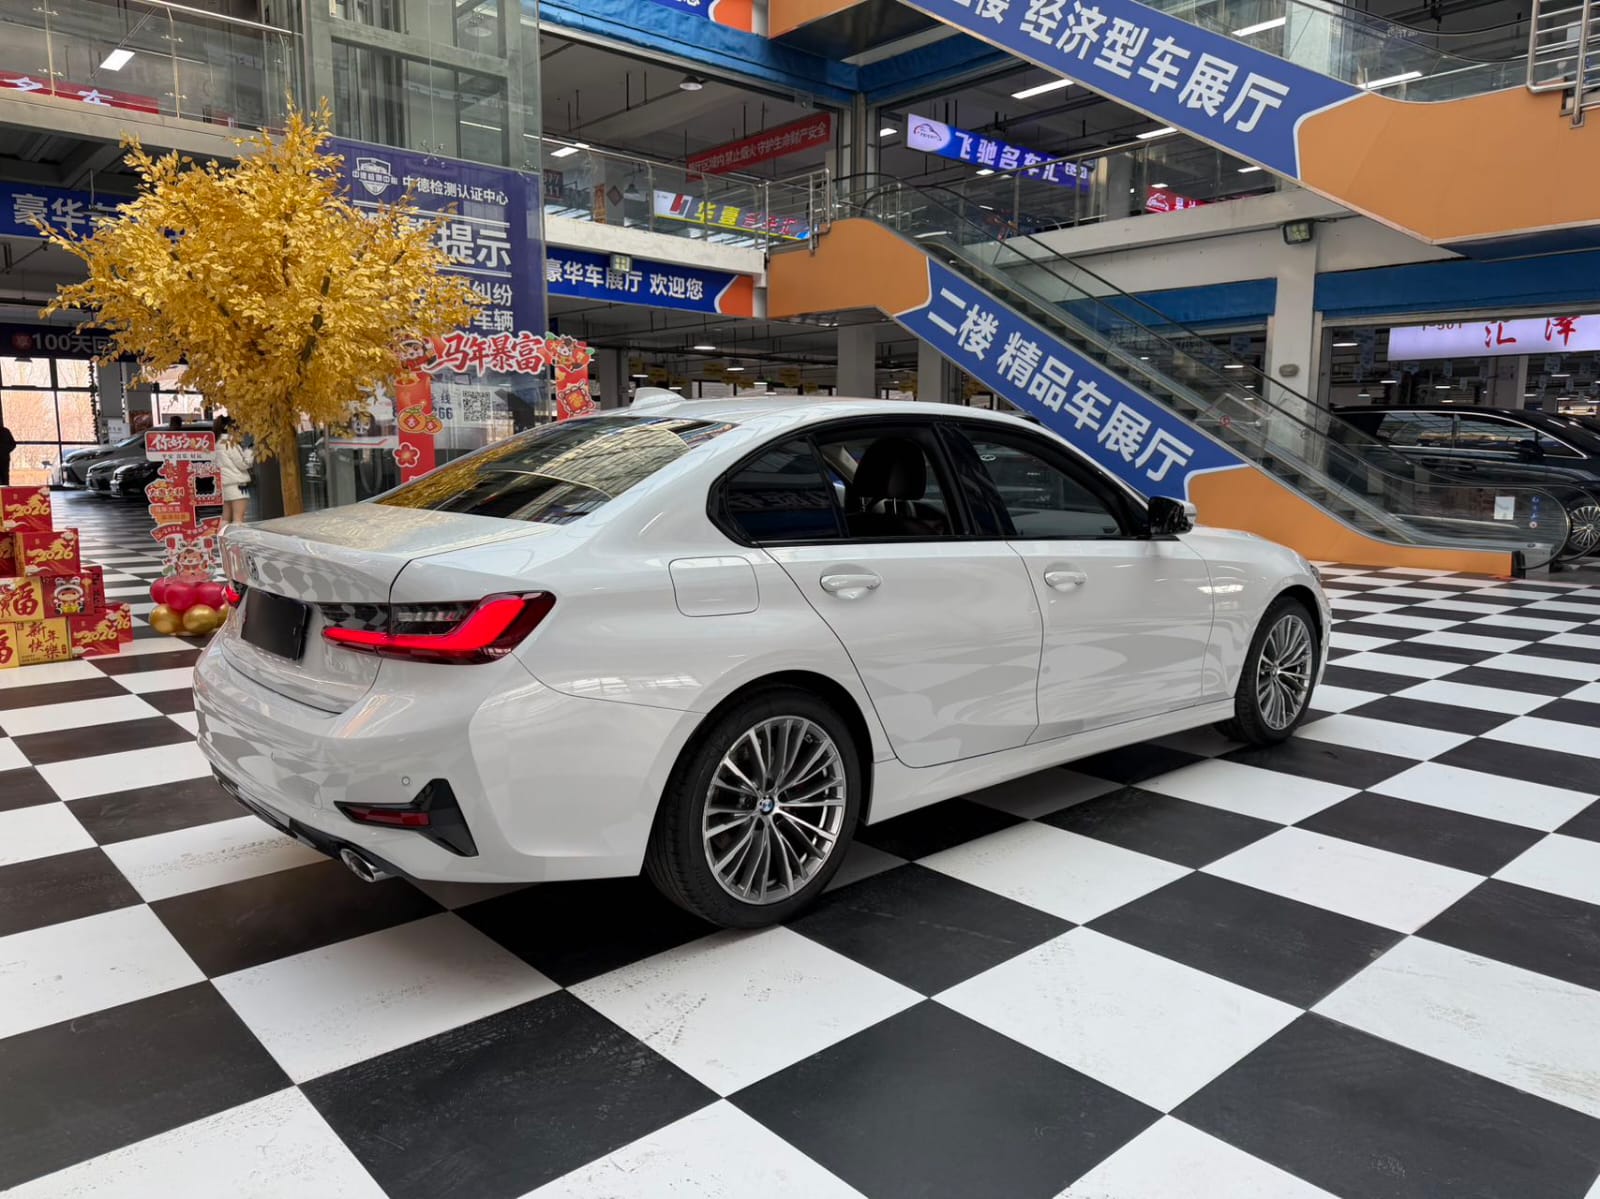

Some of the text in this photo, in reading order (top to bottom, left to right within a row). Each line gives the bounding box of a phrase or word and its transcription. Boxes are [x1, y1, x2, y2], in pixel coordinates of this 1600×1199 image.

[1019, 0, 1290, 132] 经济型车展厅
[955, 131, 1060, 182] 飞驰名车汇
[402, 175, 509, 206] 中德检测认证中心
[650, 273, 704, 301] 欢迎您
[424, 332, 545, 376] 马年暴富
[928, 287, 1194, 482] 二楼 精品车展厅
[35, 546, 74, 564] 2026
[13, 581, 39, 616] 福
[81, 627, 118, 646] 2026
